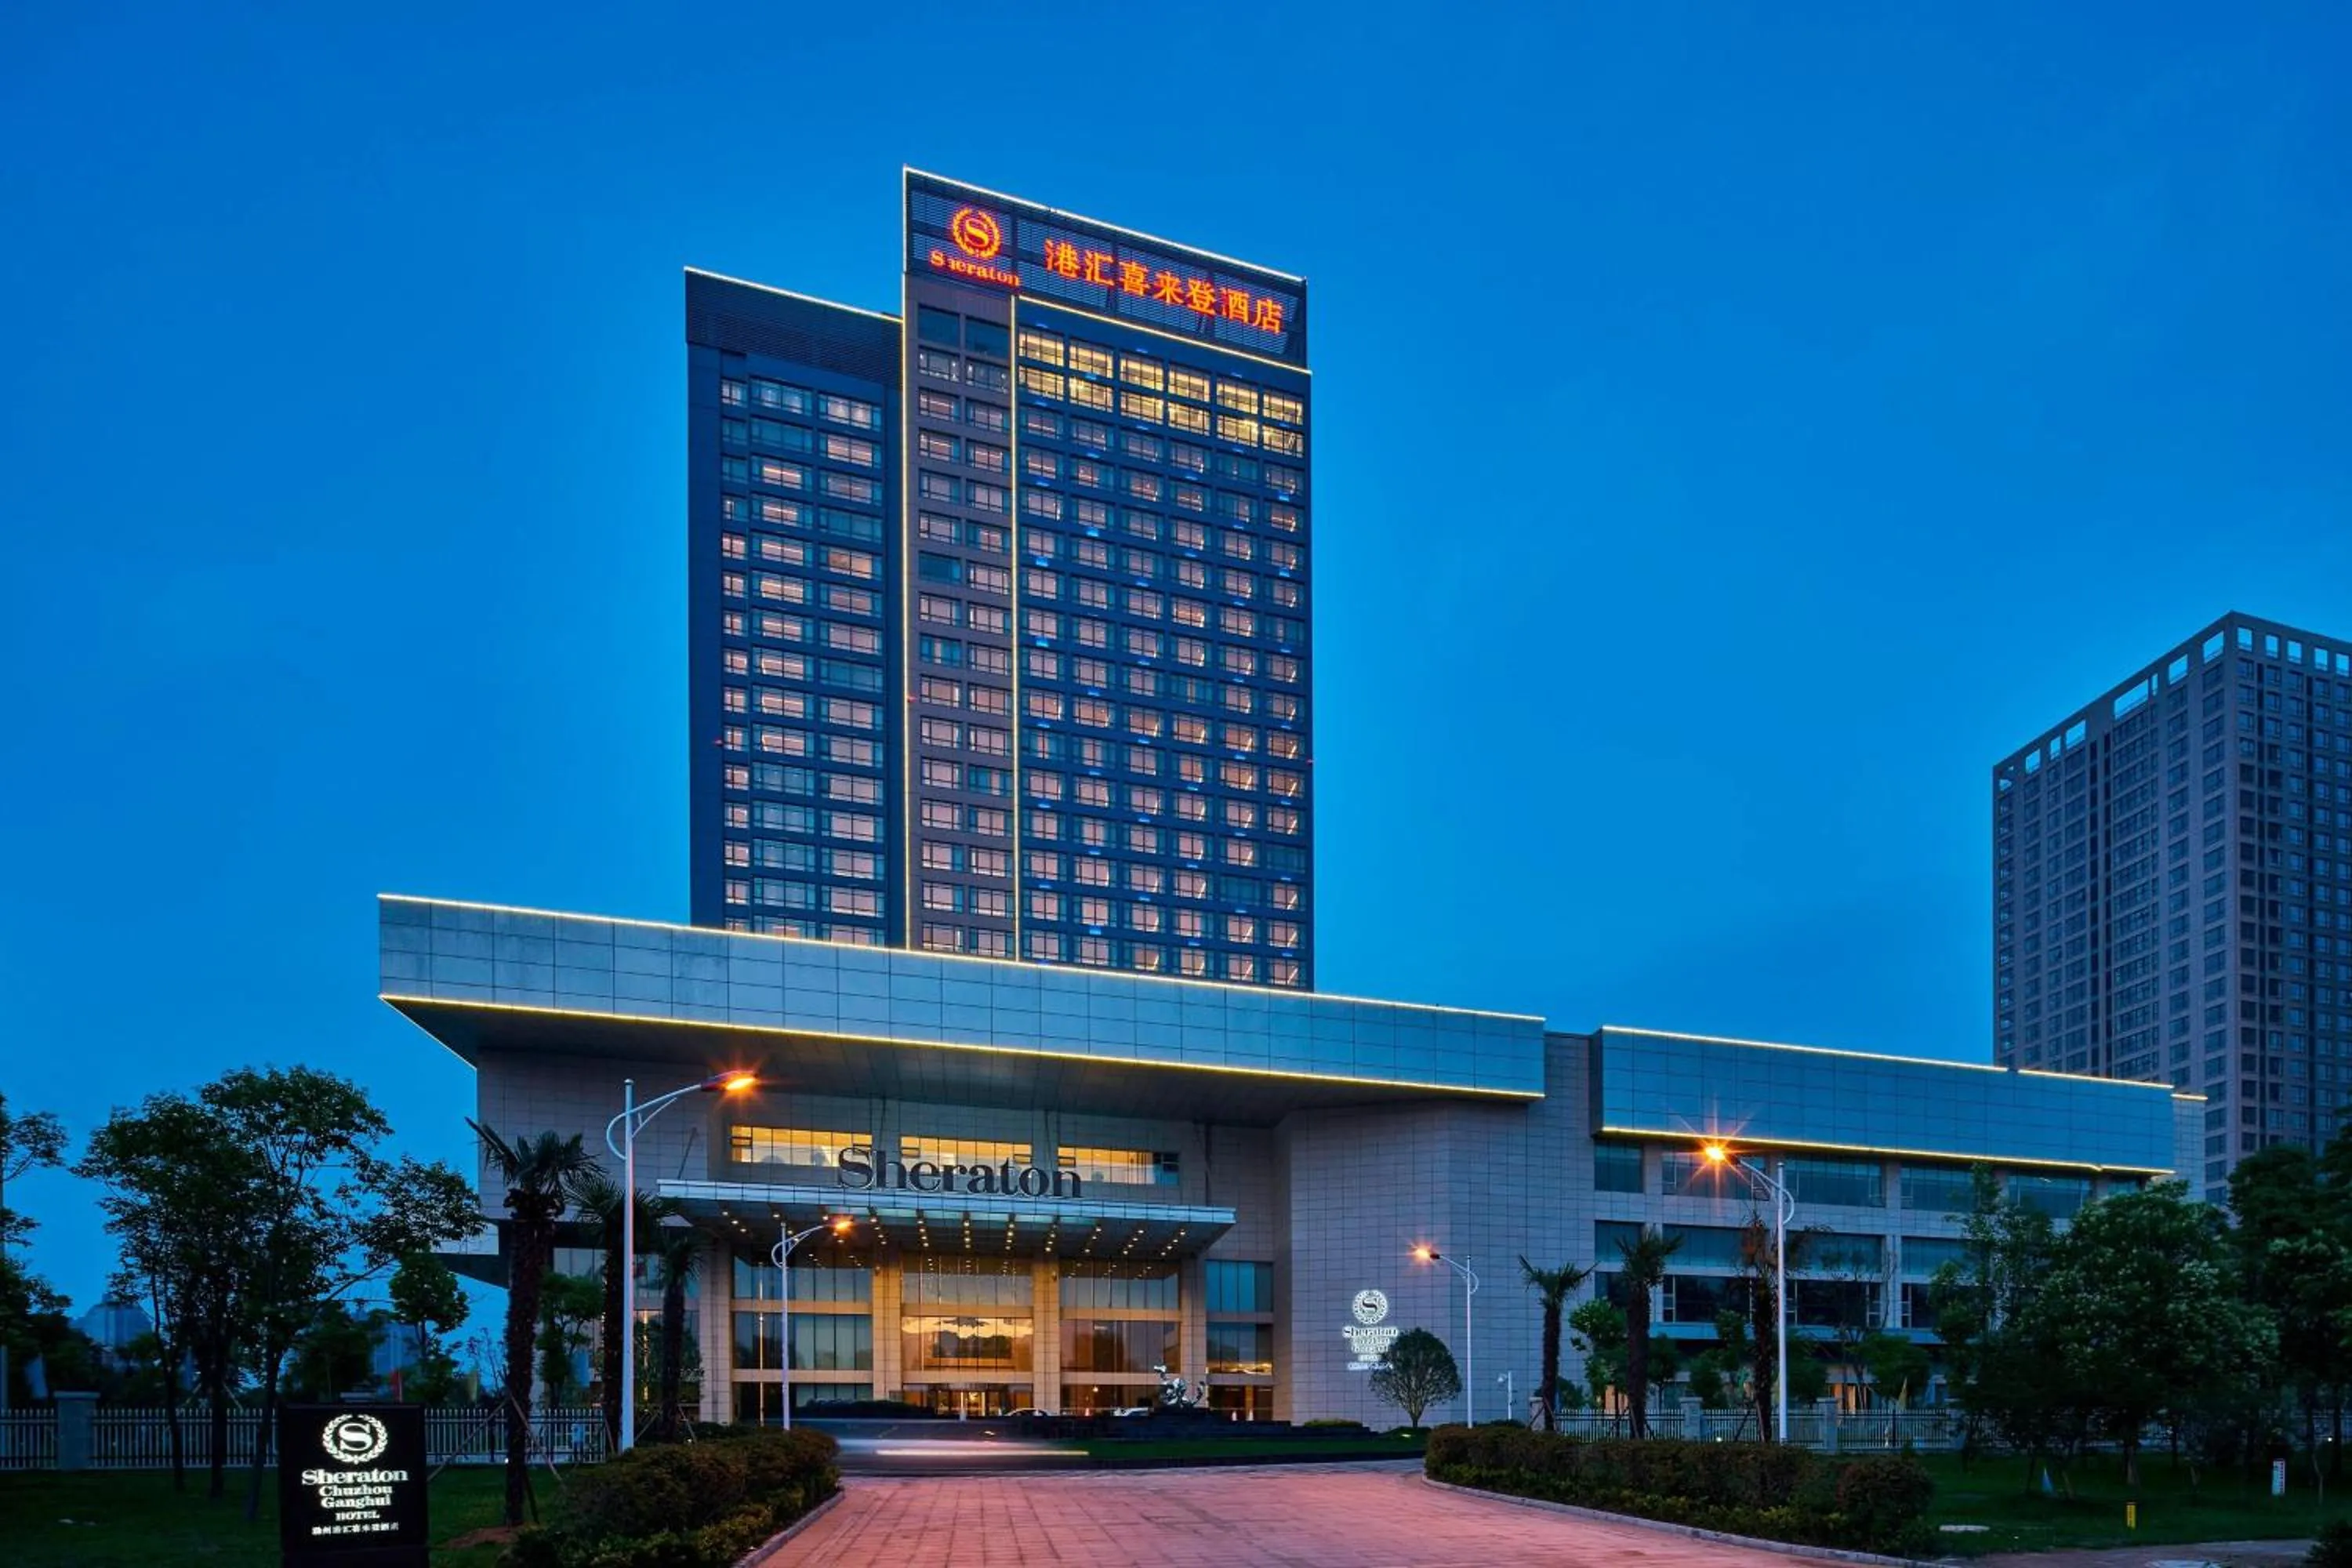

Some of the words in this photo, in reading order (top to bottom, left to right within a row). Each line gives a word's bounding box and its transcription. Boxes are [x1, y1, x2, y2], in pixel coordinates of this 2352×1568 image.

[965, 218, 989, 247] S
[1044, 238, 1283, 334] 港汇喜来登酒店
[837, 1148, 1081, 1198] Sheraton
[339, 1424, 372, 1451] S
[301, 1469, 408, 1485] Sheraton
[319, 1485, 393, 1497] Chuzhou
[321, 1495, 391, 1508] Ganghui
